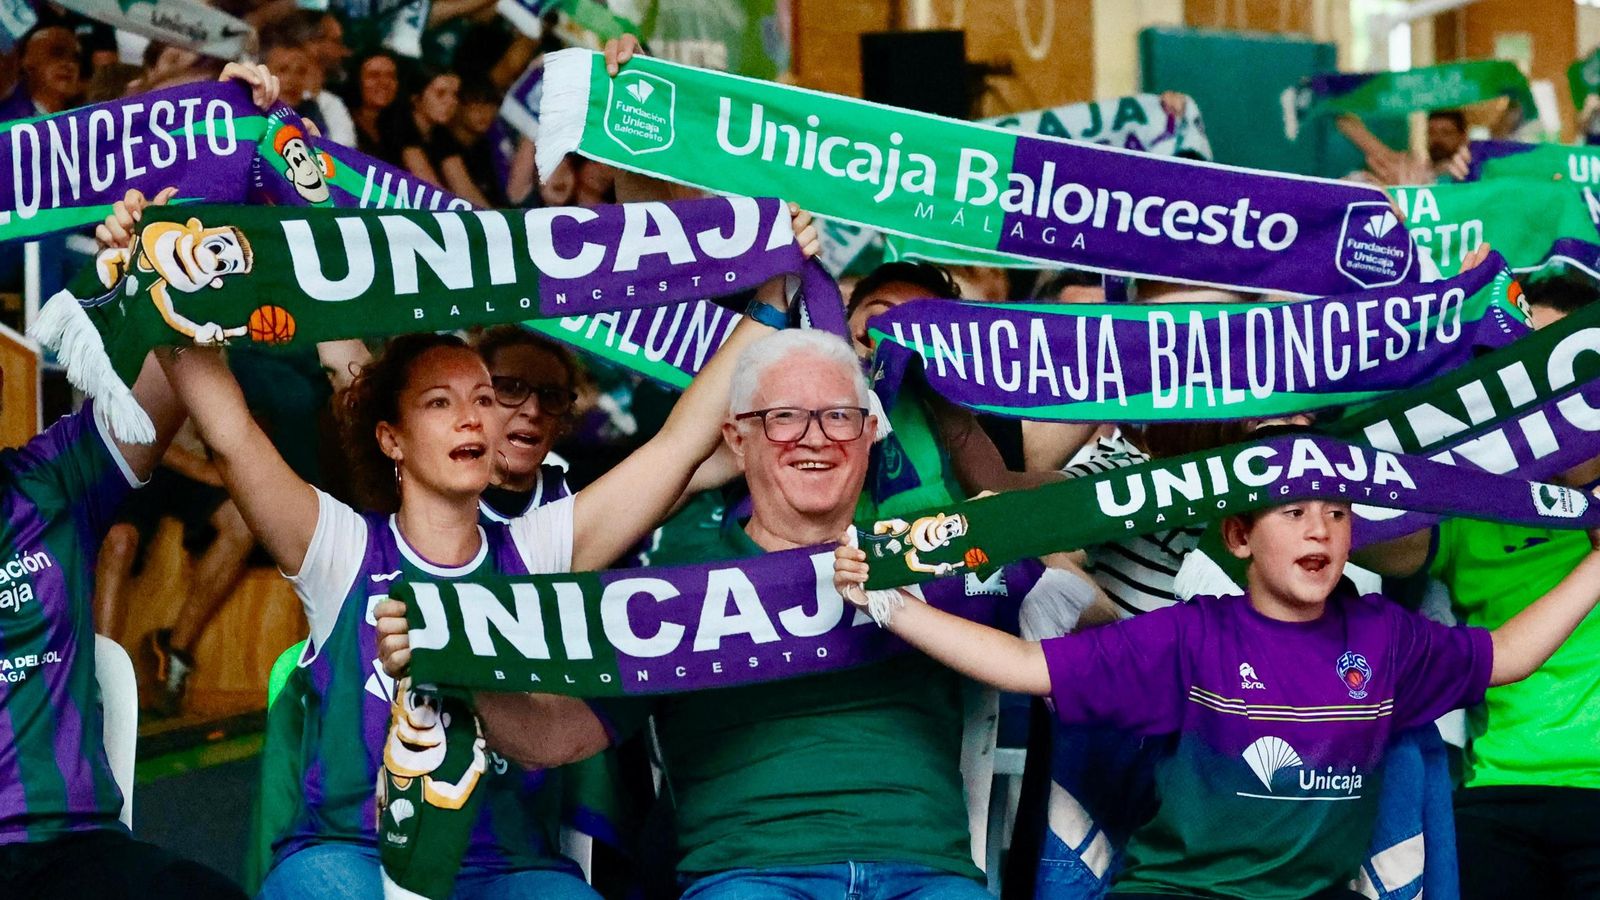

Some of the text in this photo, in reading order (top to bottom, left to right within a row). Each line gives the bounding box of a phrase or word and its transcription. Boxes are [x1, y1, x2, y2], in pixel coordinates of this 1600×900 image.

[616, 100, 666, 124] Fundación
[622, 114, 659, 133] Unicaja
[716, 97, 1299, 251] Unicaja Baloncesto
[914, 202, 1086, 250] MÁLAGA
[1347, 238, 1404, 258] Fundación
[413, 271, 736, 319] BALONCESTO
[892, 288, 1465, 408] UNICAJA BALONCESTO
[1095, 437, 1417, 515] UNICAJA
[1125, 480, 1399, 529] BALONCESTO
[494, 647, 829, 684] BALONCESTO
[1299, 765, 1362, 795] Unicaja
